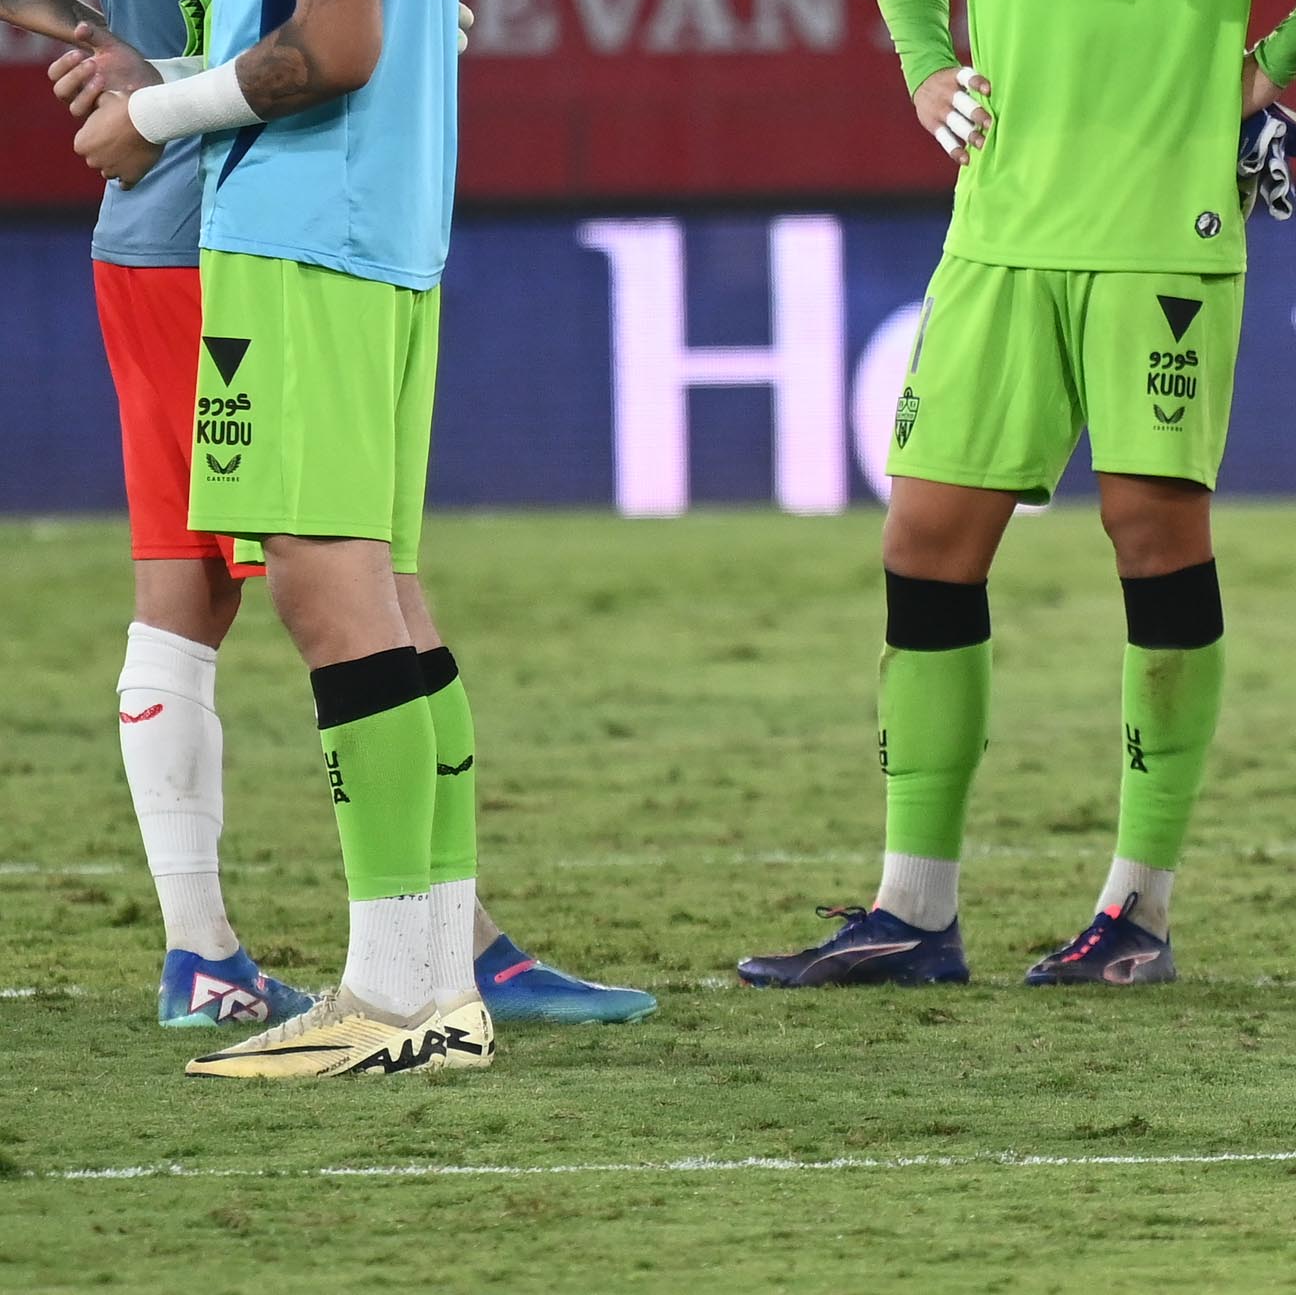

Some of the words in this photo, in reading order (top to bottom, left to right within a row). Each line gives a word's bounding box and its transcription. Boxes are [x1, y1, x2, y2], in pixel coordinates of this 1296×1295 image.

[1147, 372, 1197, 399] KUDU
[197, 419, 252, 446] KUDU
[324, 750, 351, 804] UDA
